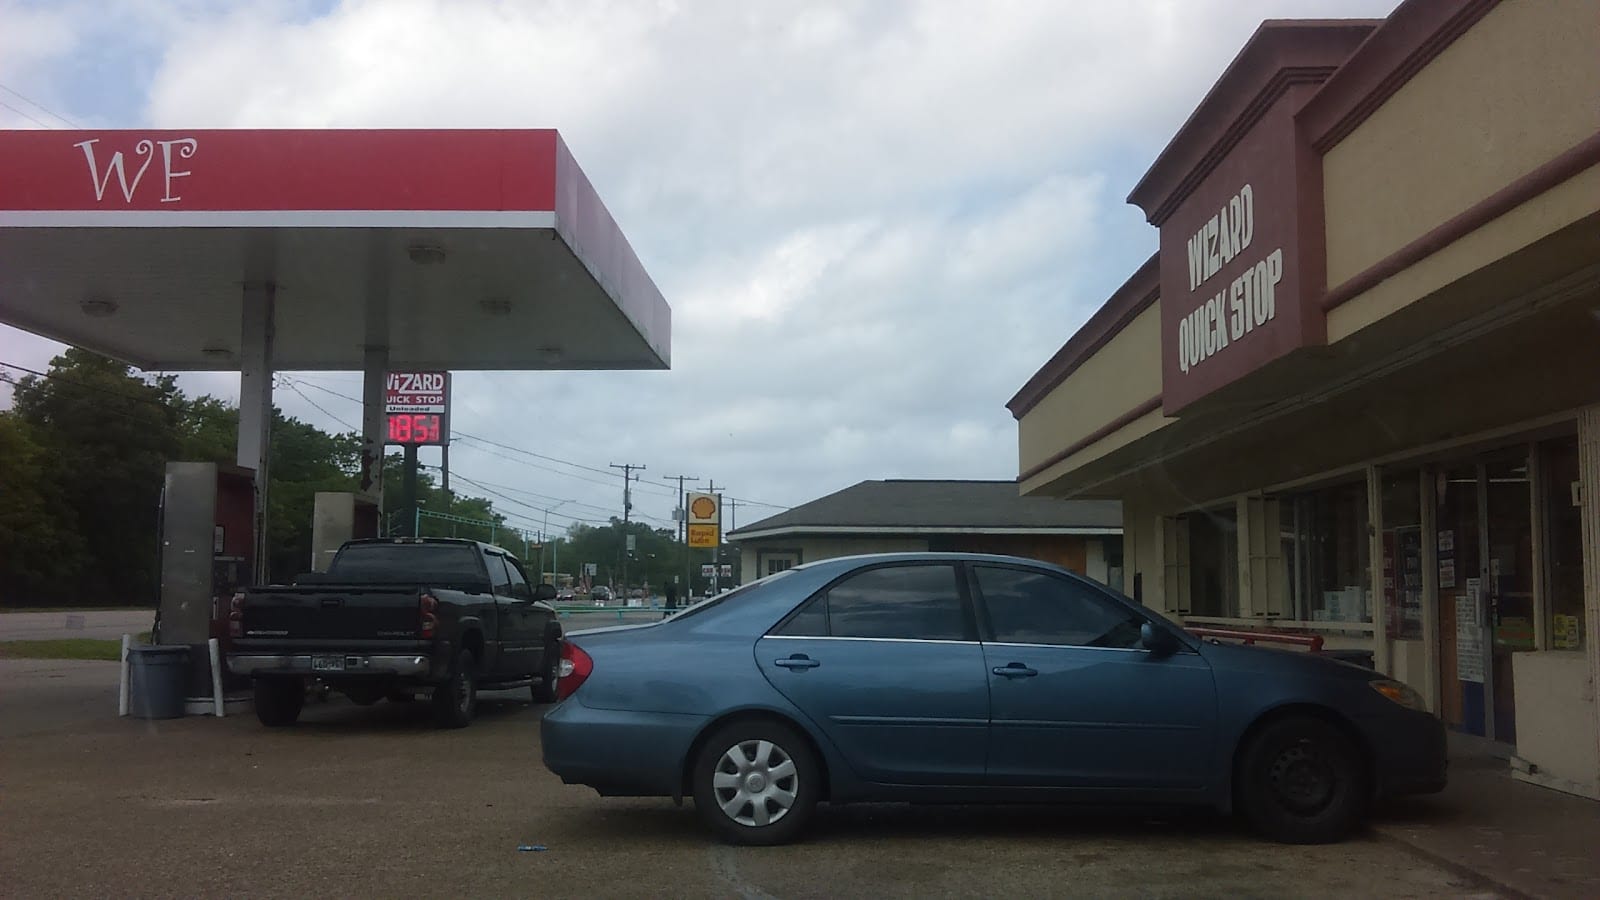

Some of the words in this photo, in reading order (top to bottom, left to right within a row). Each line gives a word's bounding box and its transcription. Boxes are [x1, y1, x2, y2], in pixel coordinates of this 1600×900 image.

[1188, 184, 1253, 292] WIZARD
[1179, 289, 1229, 375] QUICK
[1231, 248, 1283, 341] STOP
